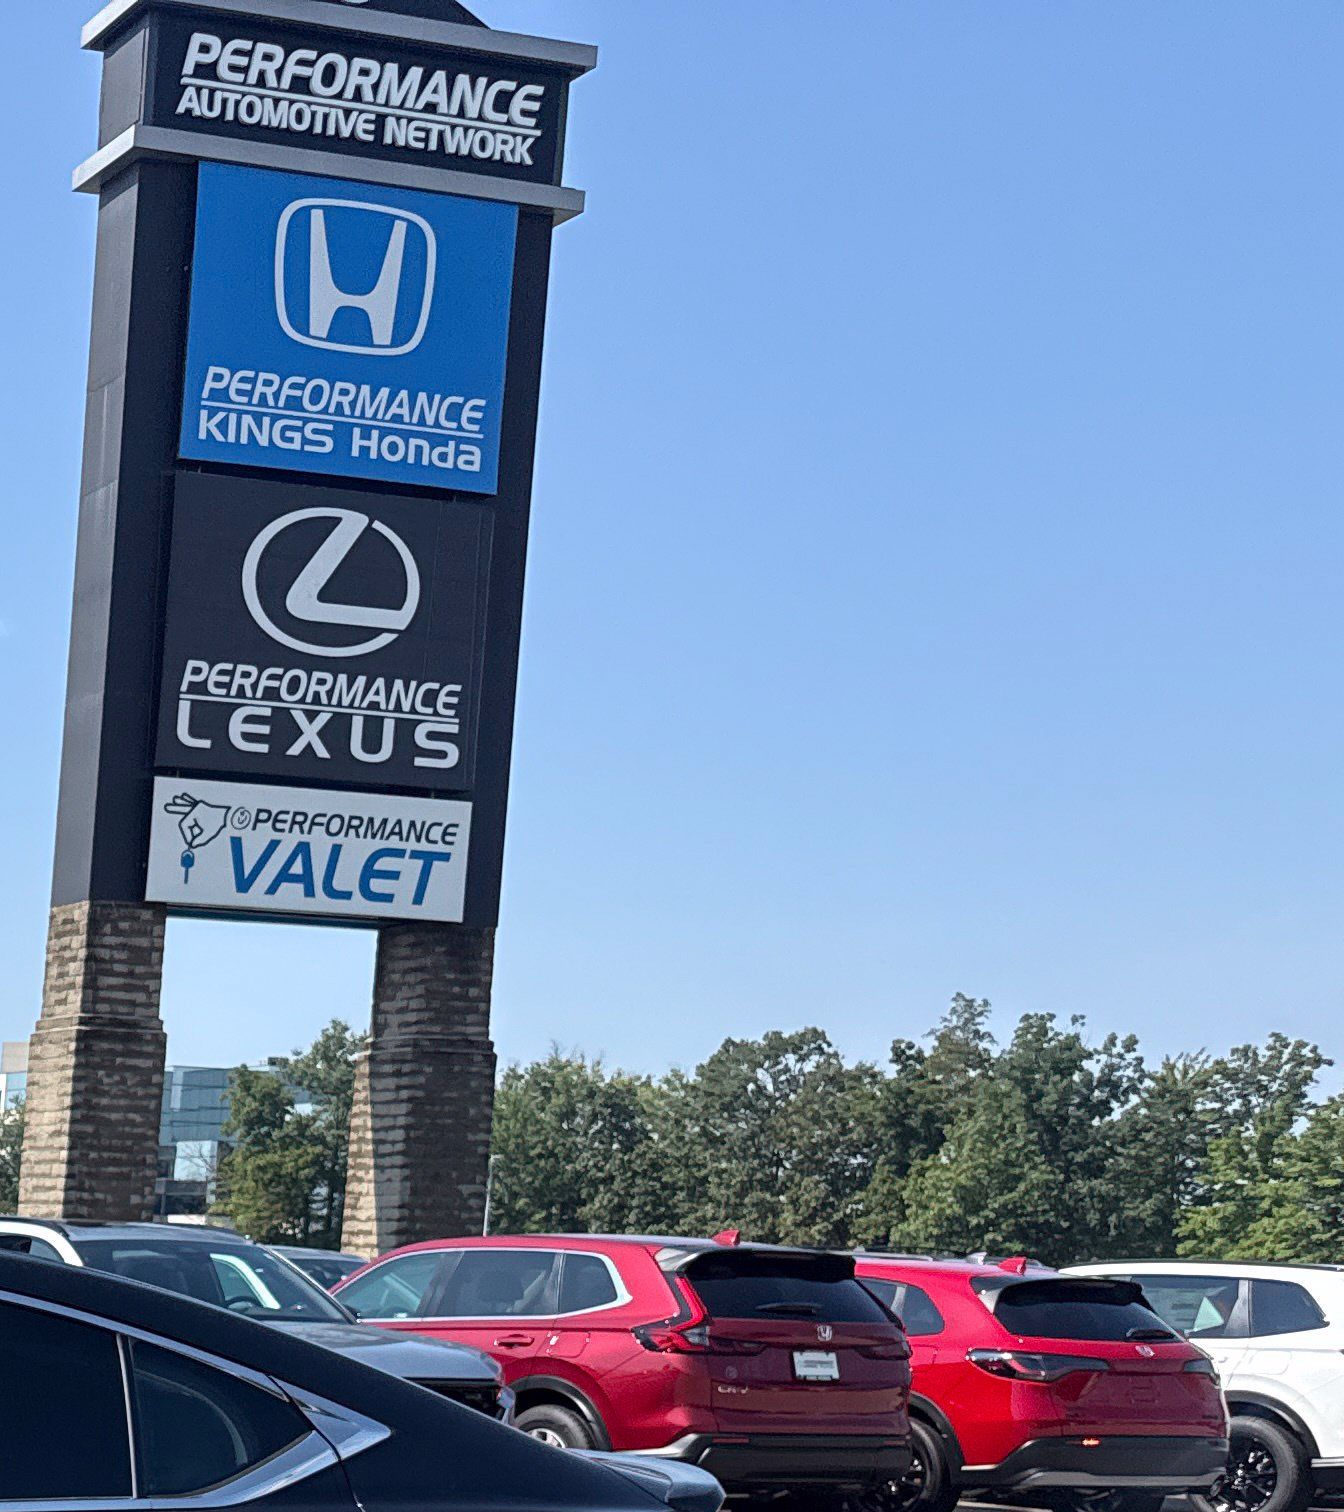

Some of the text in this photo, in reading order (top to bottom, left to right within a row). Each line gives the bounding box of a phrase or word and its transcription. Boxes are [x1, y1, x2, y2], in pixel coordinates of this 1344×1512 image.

[181, 32, 545, 128] PERFORMANCE
[175, 85, 536, 166] AUTOMOTIVE NETWORK
[201, 365, 486, 432] PERFORMANCE
[198, 409, 482, 472] KINGS Honda
[179, 658, 463, 718] PERFORMANCE
[176, 699, 460, 769] LEXUS
[250, 807, 459, 847] PERFORMANCE
[229, 835, 451, 906] VALET
